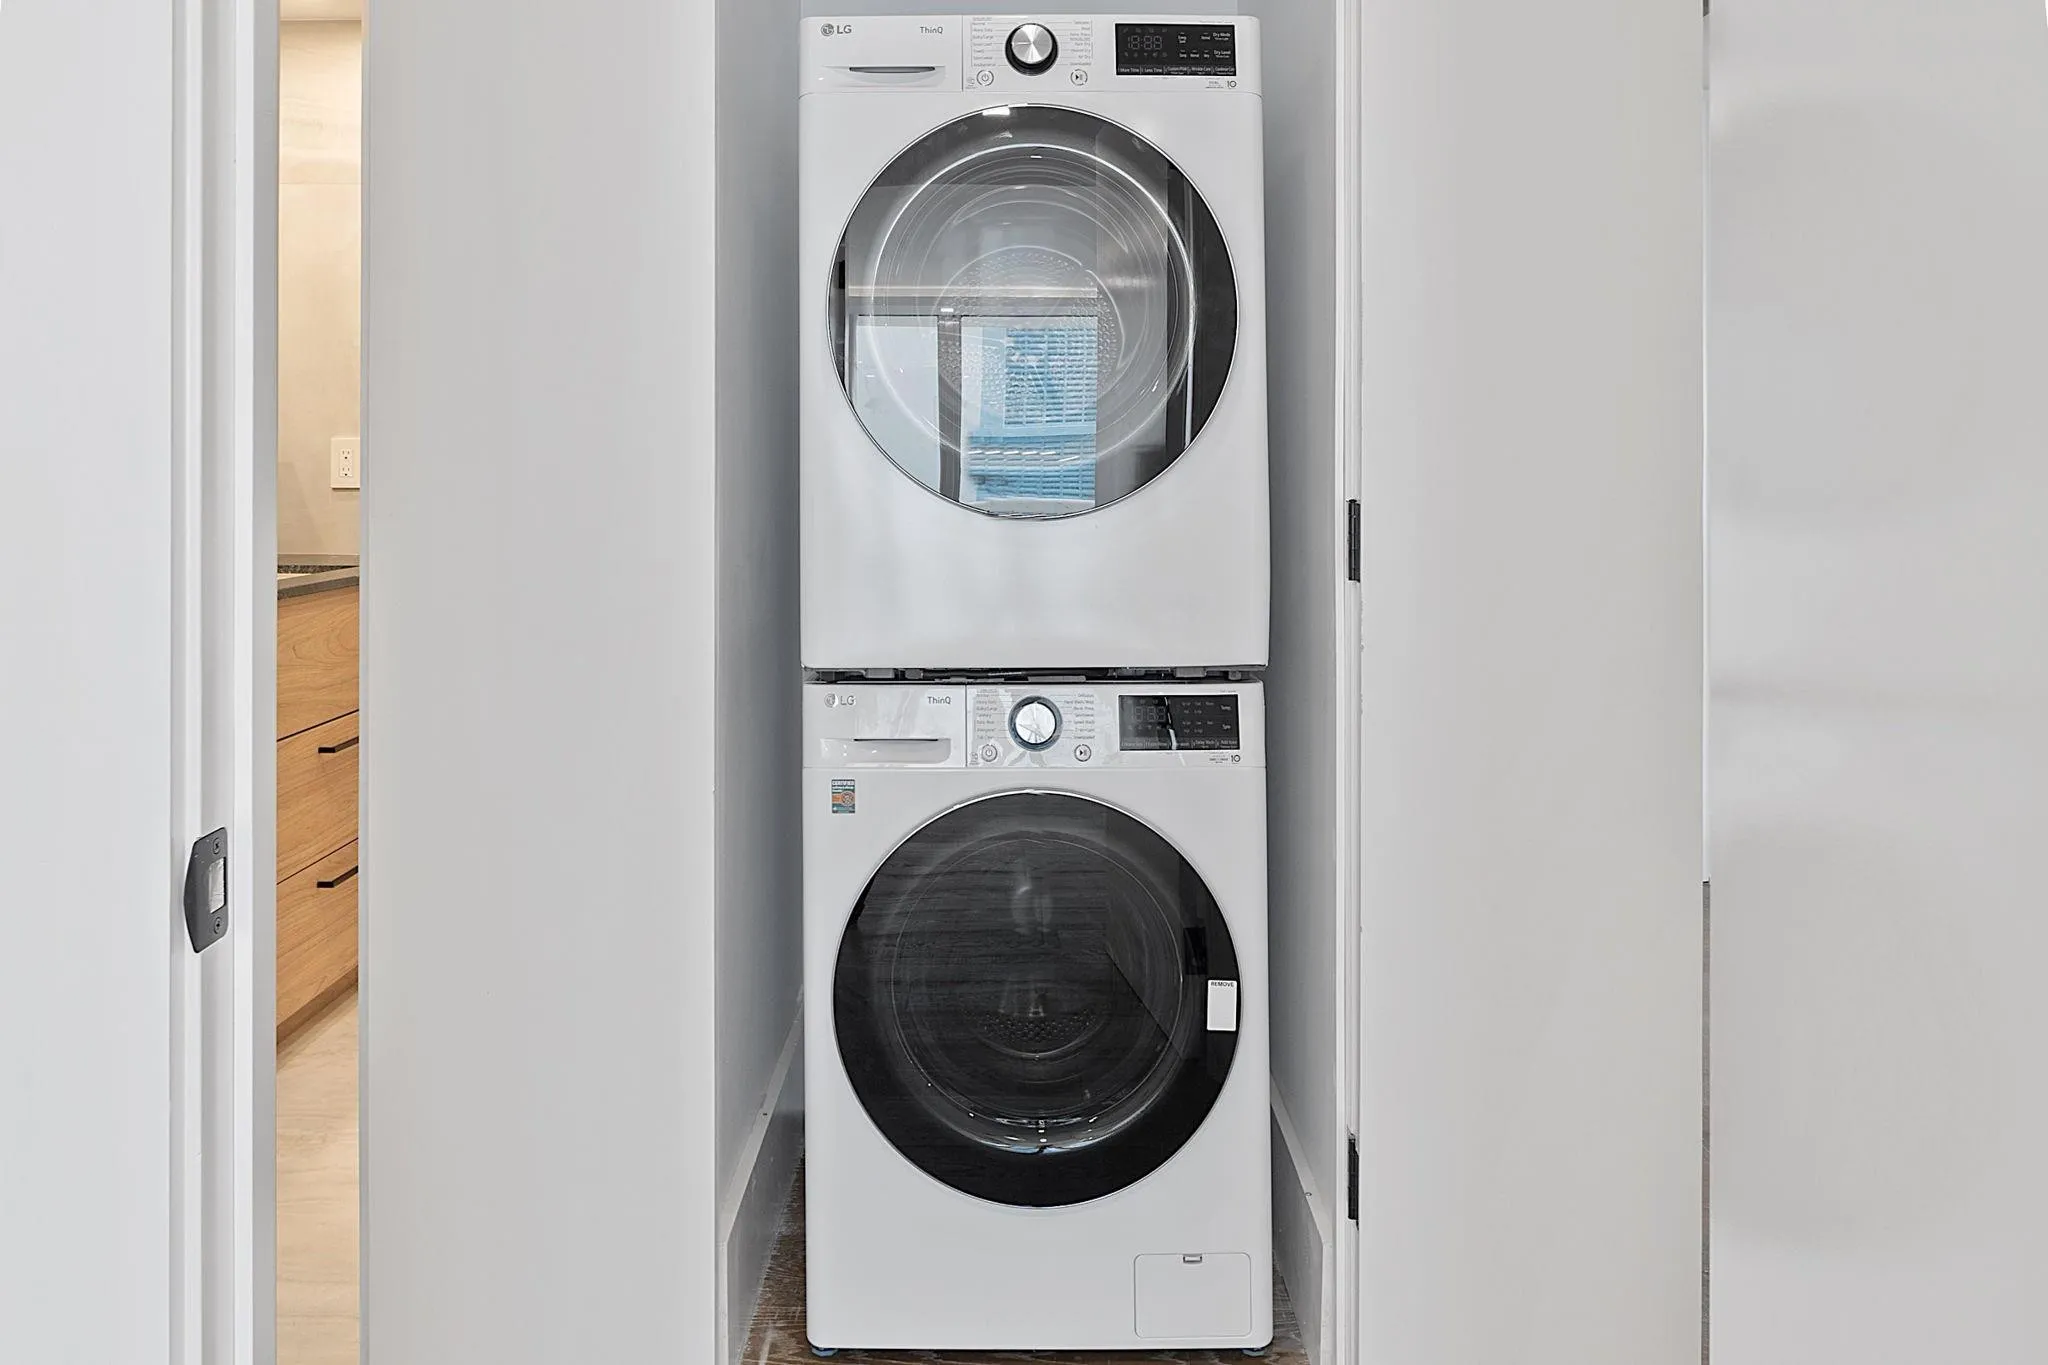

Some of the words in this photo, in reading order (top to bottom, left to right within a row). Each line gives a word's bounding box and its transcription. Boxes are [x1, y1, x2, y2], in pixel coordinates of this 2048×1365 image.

[836, 24, 852, 34] LG
[919, 26, 943, 34] ThinQ
[840, 695, 855, 706] LG
[928, 696, 952, 704] ThinQ
